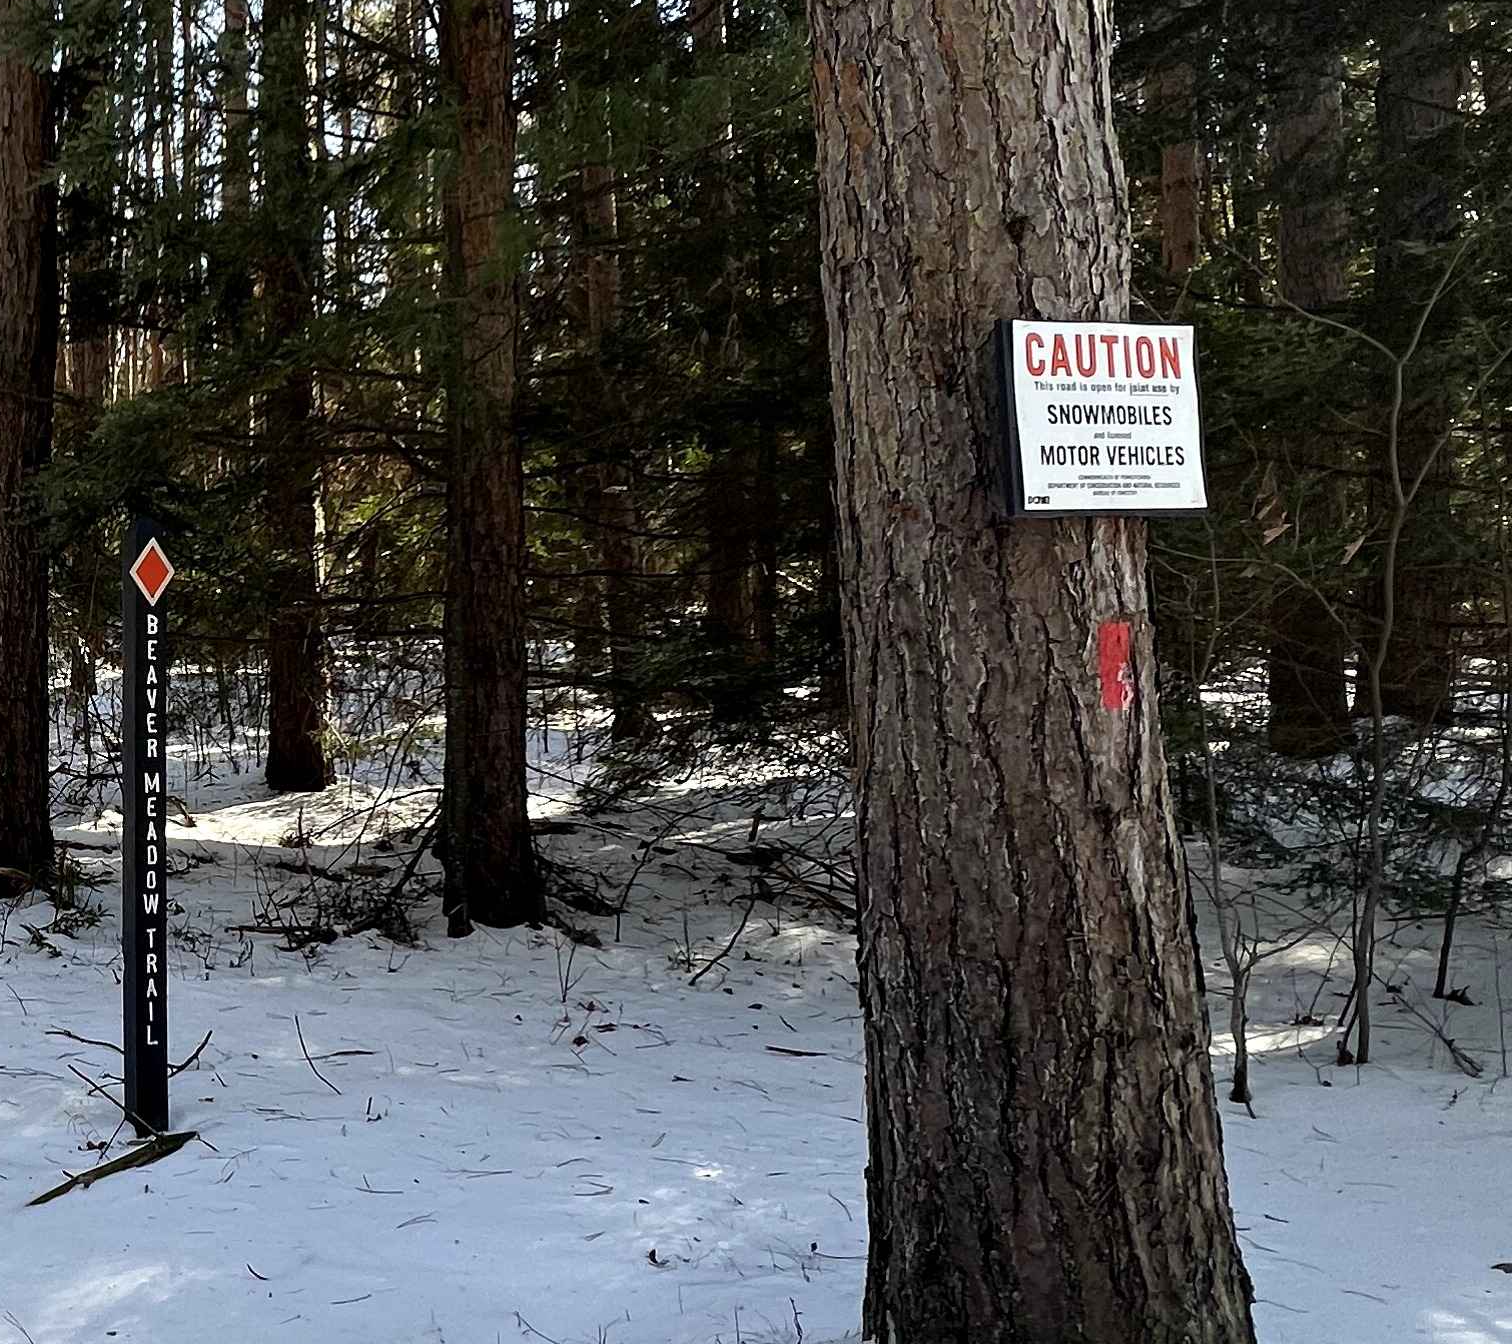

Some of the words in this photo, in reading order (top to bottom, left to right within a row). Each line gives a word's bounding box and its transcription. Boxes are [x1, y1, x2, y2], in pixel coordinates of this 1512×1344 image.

[1025, 332, 1182, 379] CAUTION
[1034, 381, 1054, 392] This
[1056, 381, 1077, 392] road
[1080, 382, 1088, 392] is
[1090, 383, 1112, 394] open
[1114, 382, 1127, 393] for
[1129, 383, 1150, 395] joint
[1152, 384, 1167, 394] use
[1170, 384, 1180, 395] by
[1047, 404, 1172, 426] SNOWMOBILES
[1040, 445, 1101, 466] MOTOR
[1106, 445, 1185, 467] VEHICLES
[146, 613, 159, 758] BEAVER
[143, 772, 160, 915] MEADOW
[146, 928, 159, 1046] TRAIL
